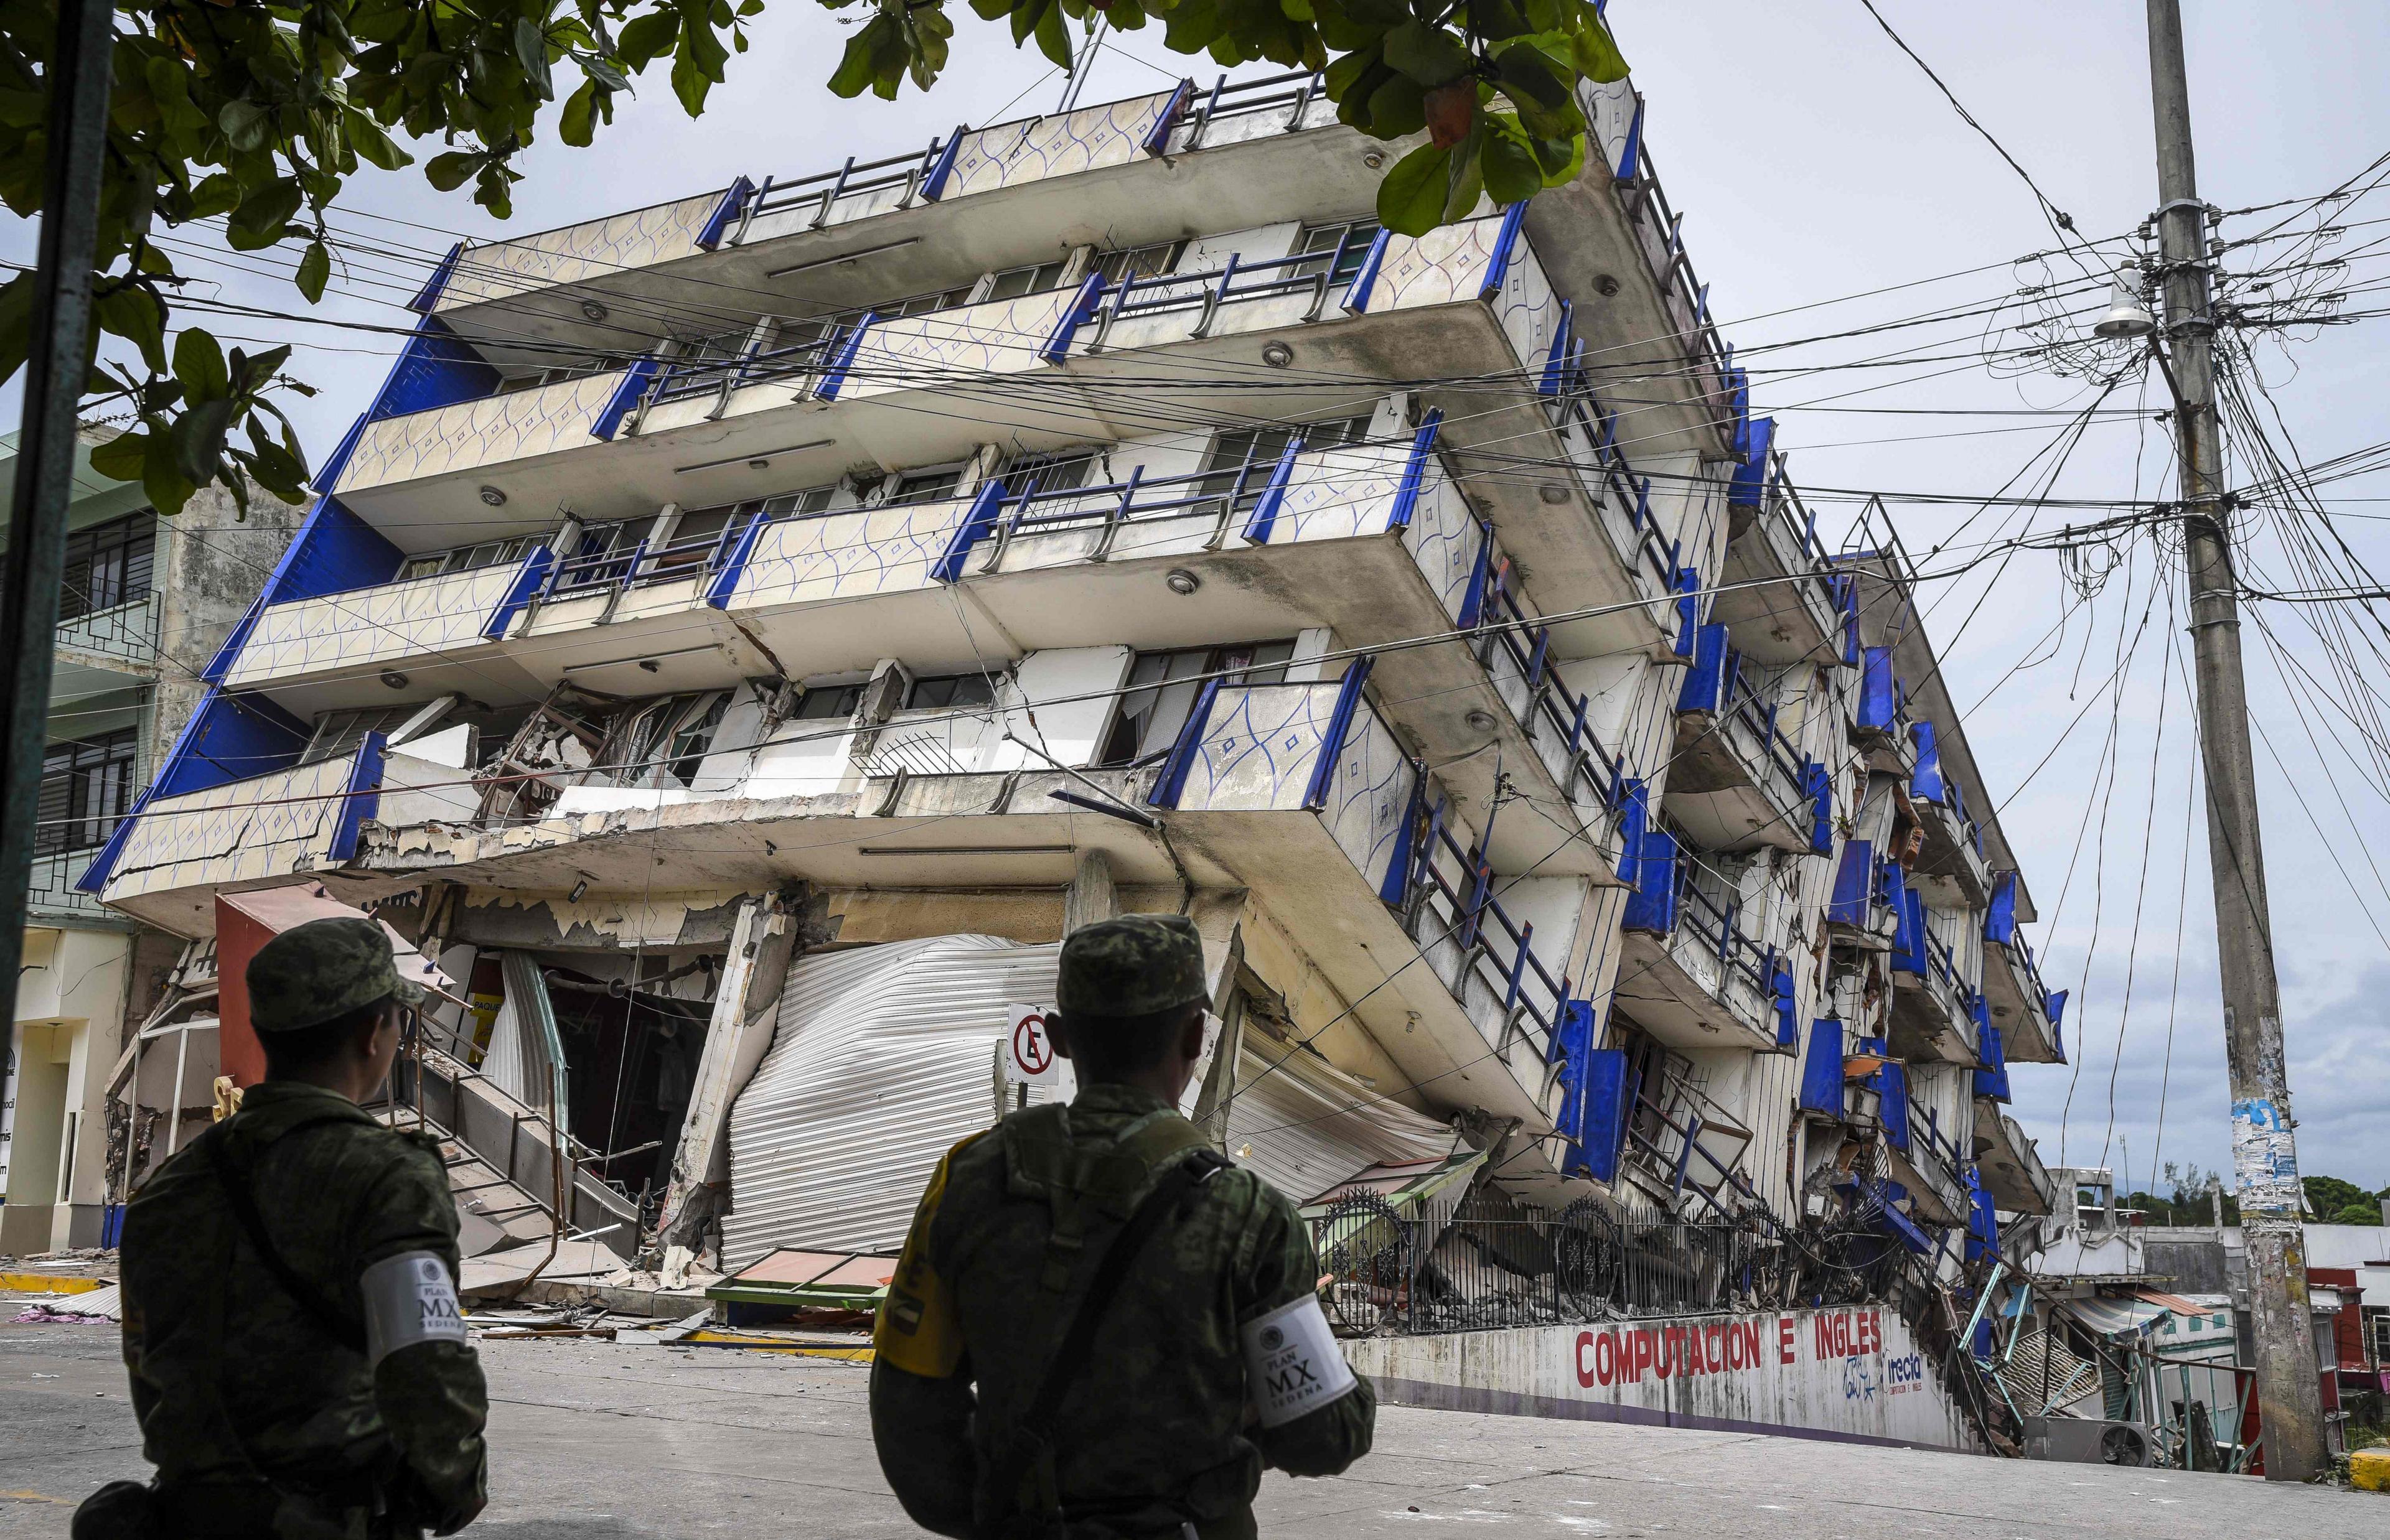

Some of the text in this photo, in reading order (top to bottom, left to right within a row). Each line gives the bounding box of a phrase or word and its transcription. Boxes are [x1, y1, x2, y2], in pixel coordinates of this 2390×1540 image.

[1027, 1032, 1041, 1058] E
[418, 1299, 461, 1320] MX
[1268, 1351, 1296, 1371] PLAN
[1575, 1311, 1881, 1388] COMPUTACION E INGLES
[1265, 1359, 1318, 1398] MX
